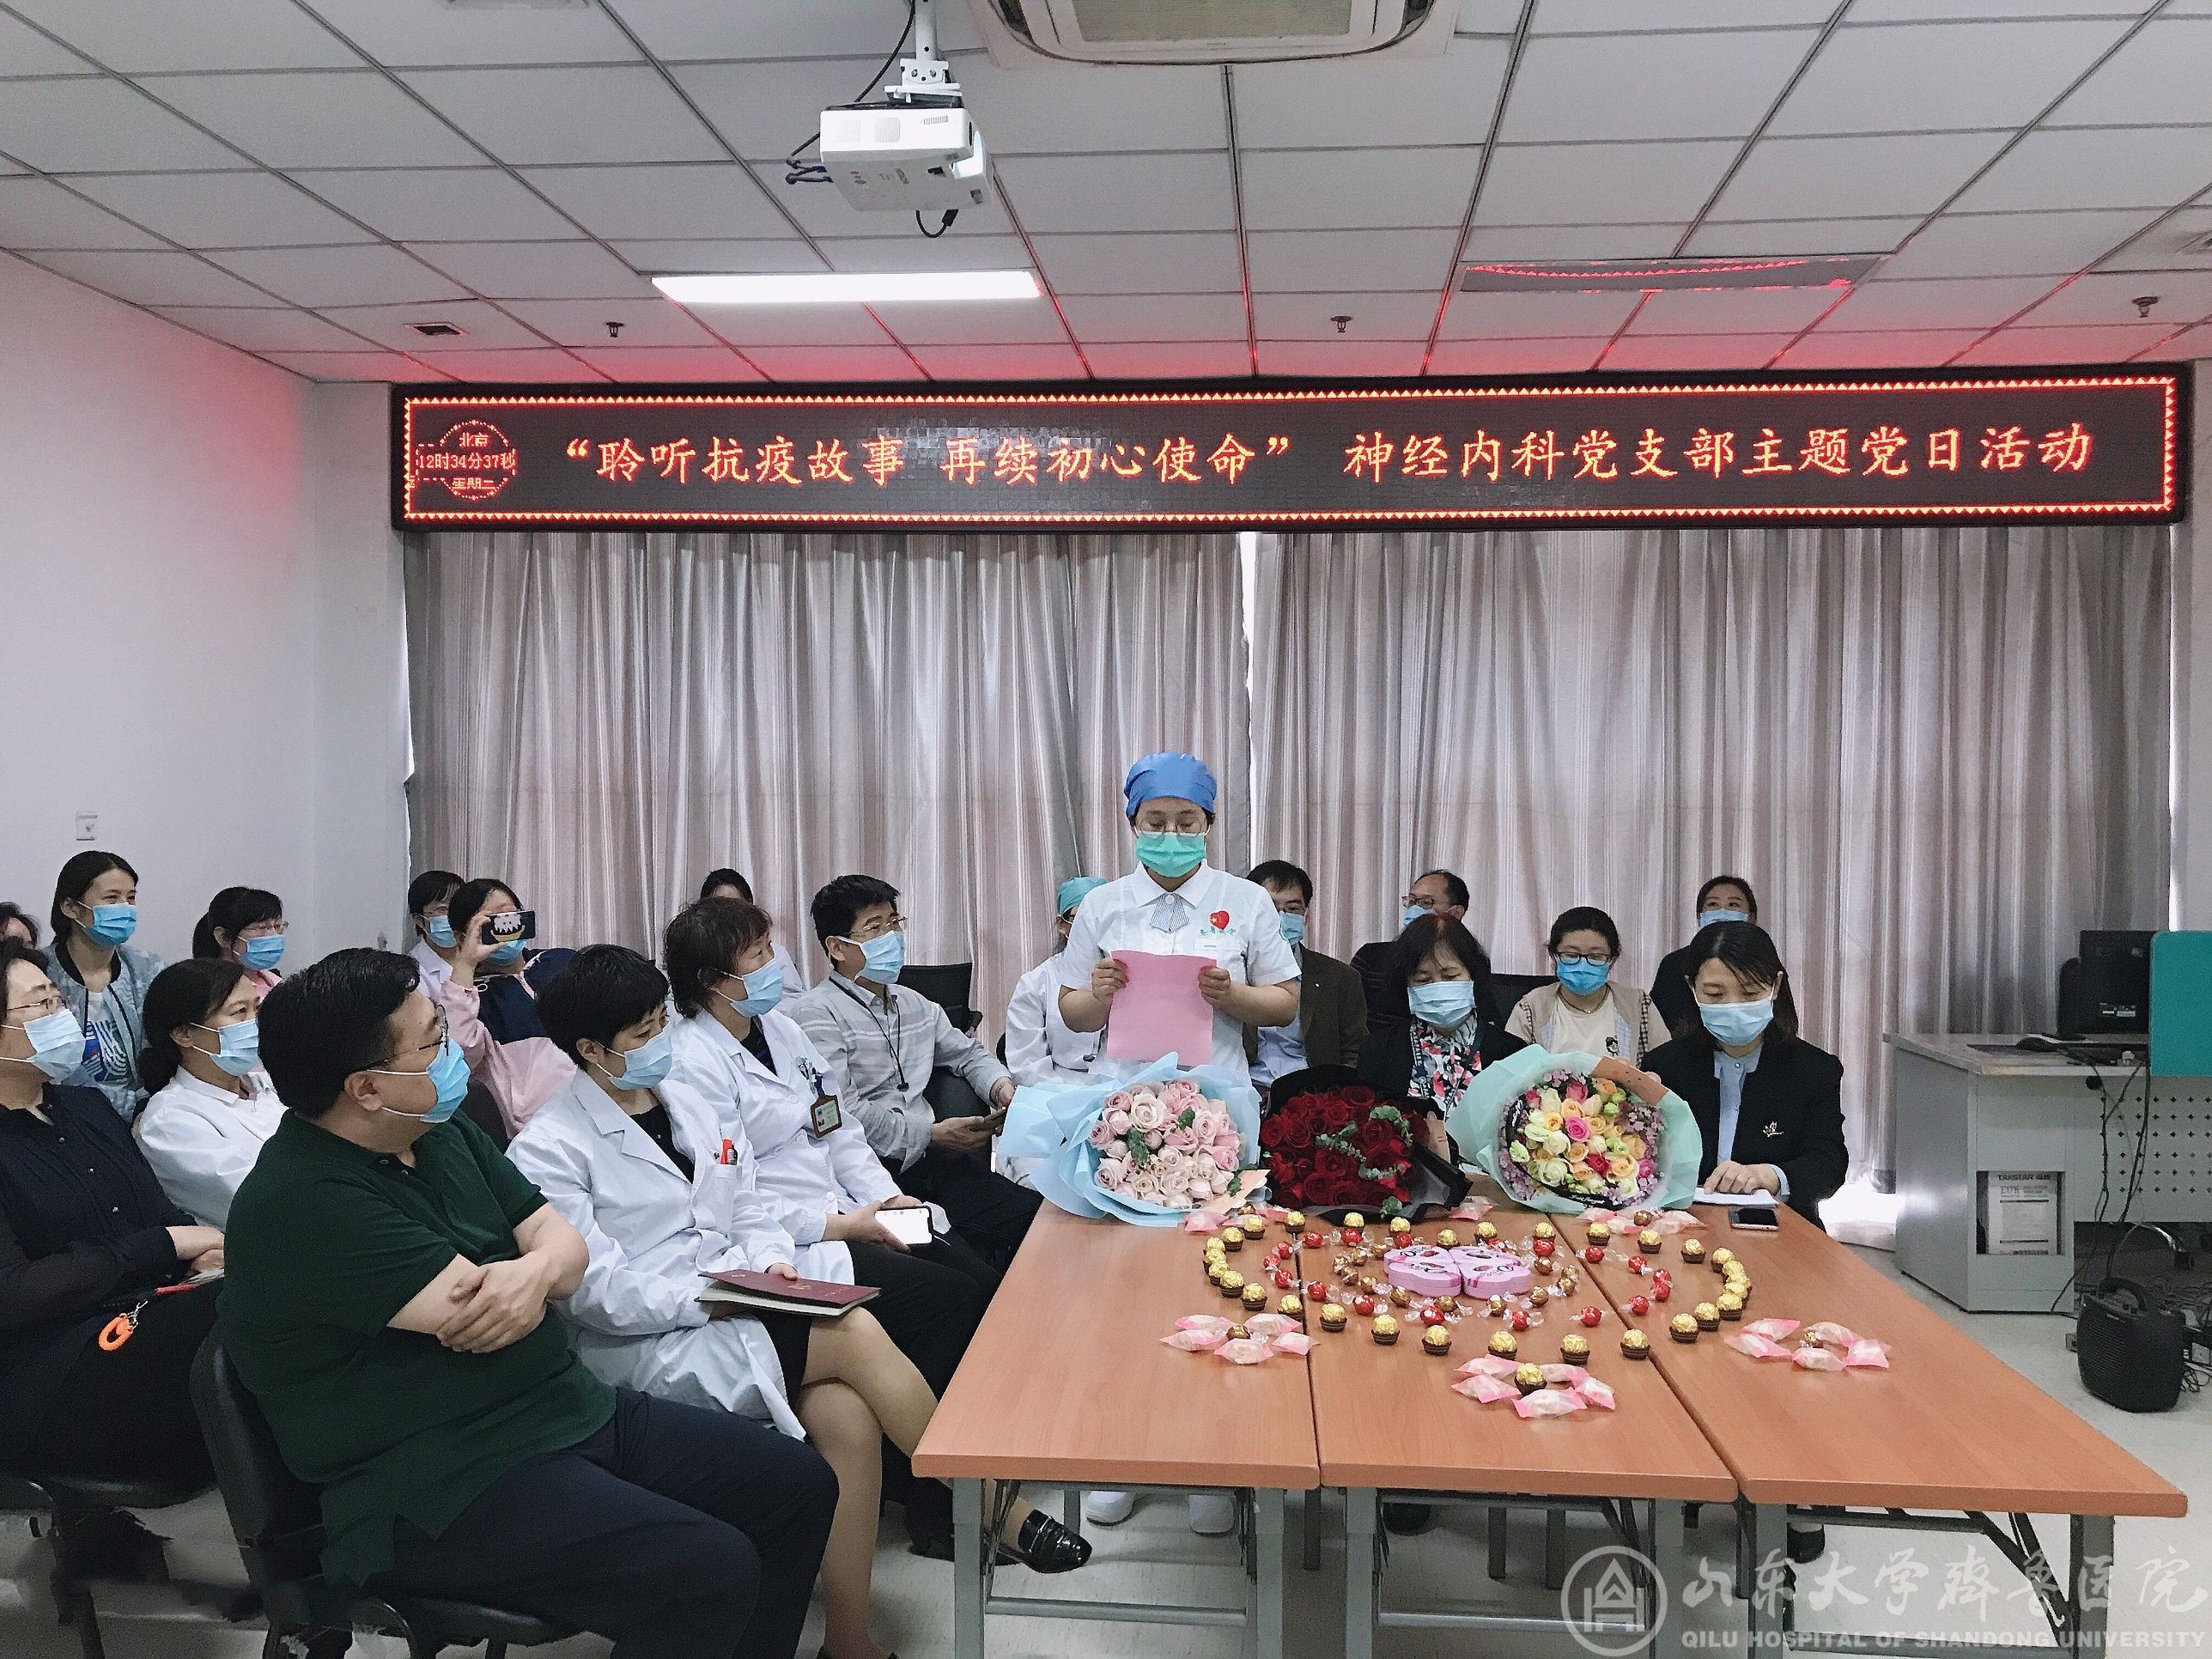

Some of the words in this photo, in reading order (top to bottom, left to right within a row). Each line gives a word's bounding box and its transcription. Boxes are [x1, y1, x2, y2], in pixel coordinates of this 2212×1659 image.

[459, 432, 489, 447] 北京
[419, 452, 515, 471] 12时34分37秒
[566, 434, 903, 485] “聆听抗疫故事
[940, 432, 1290, 484] 再续初心使命”
[1342, 422, 2093, 484] 神经内科党支部主题党日活动
[452, 477, 496, 490] 星期二
